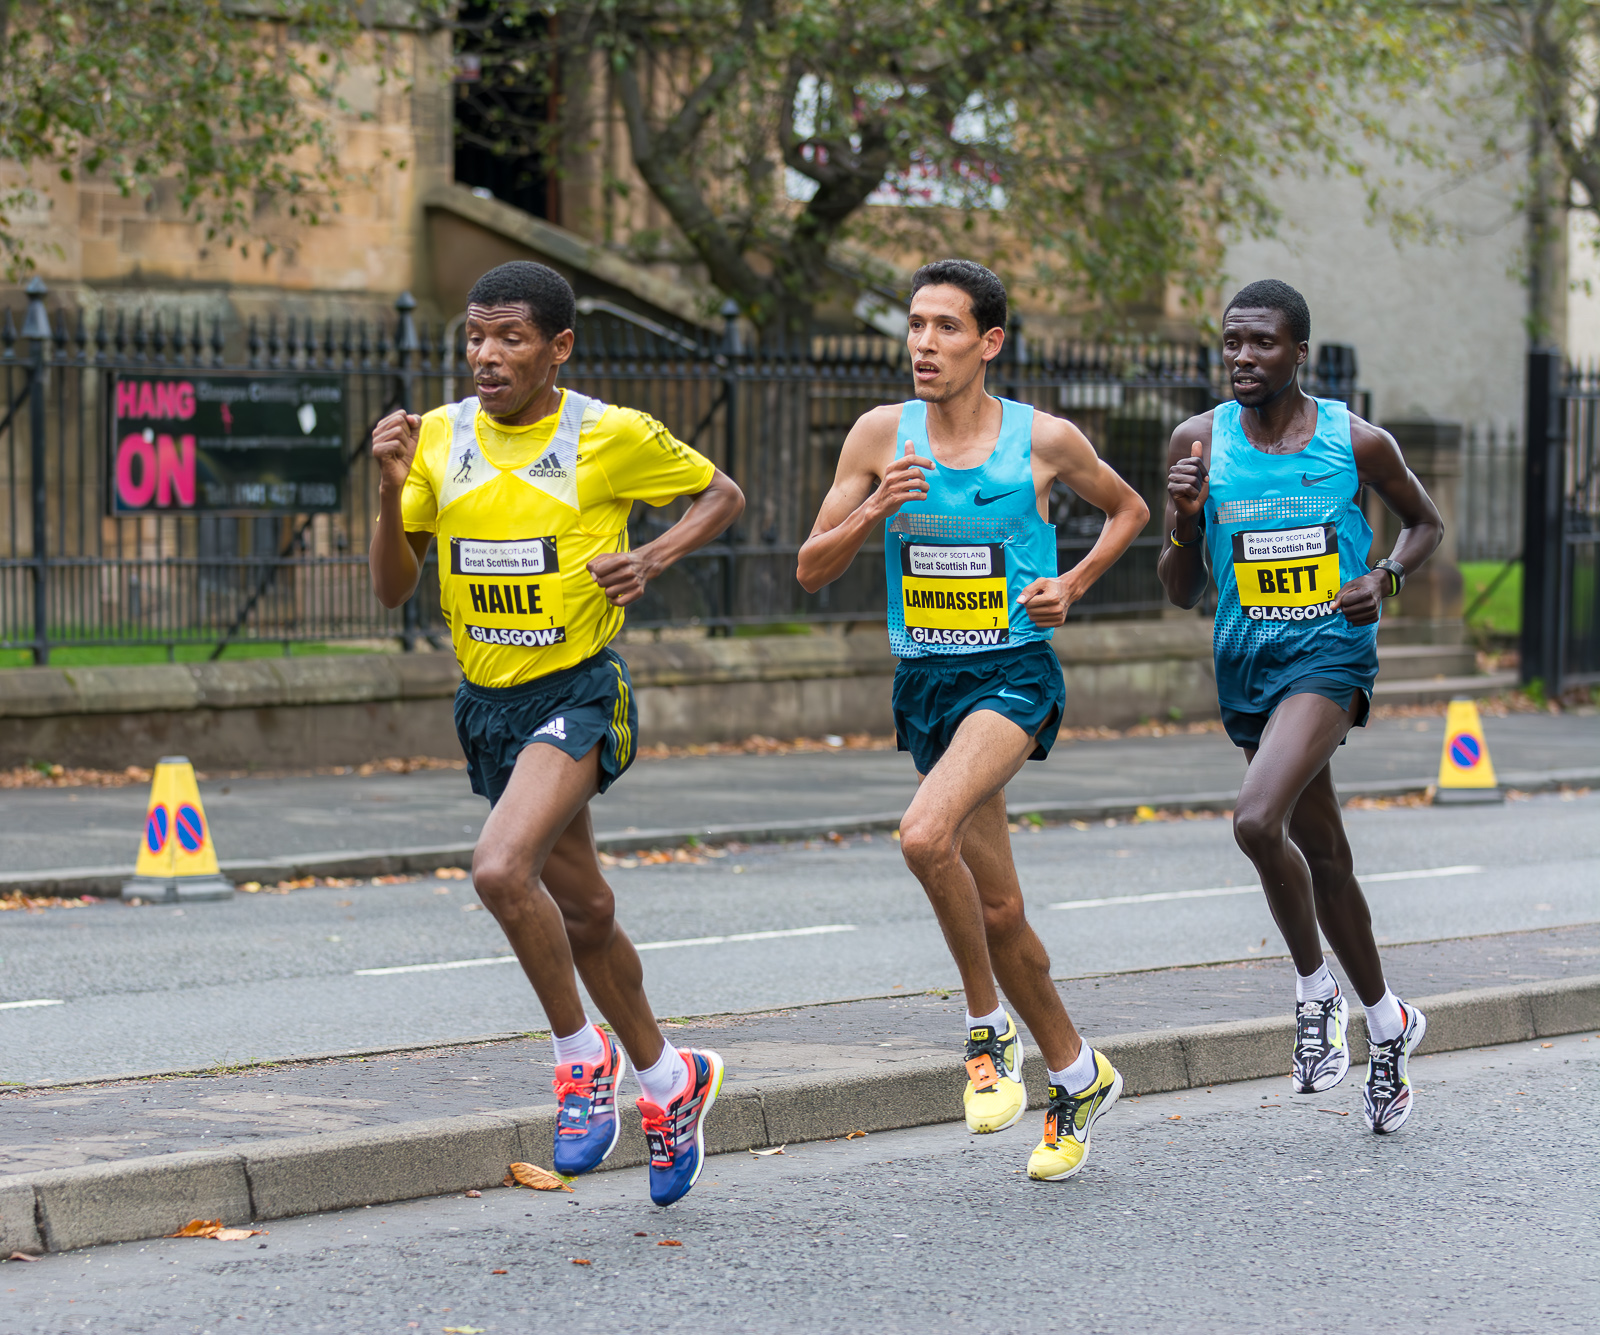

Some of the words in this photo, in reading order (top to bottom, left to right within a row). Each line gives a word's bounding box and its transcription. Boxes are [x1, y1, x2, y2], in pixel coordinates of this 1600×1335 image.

[117, 381, 197, 420] HANG
[117, 432, 197, 508] ON
[529, 468, 567, 478] adidas
[1286, 532, 1321, 542] SCOTLAND
[472, 547, 487, 555] BANK
[500, 547, 538, 556] SCOTLAND
[1249, 546, 1270, 555] Great
[1272, 543, 1305, 554] Scottish
[1306, 542, 1322, 551] Run
[920, 551, 938, 559] BANK
[939, 551, 948, 559] OF
[949, 551, 986, 559] SCOTLAND
[465, 557, 485, 567] Great
[486, 558, 520, 568] Scottish
[521, 558, 539, 567] Run
[914, 560, 934, 570] Great
[935, 561, 968, 571] Scottish
[970, 562, 987, 570] Run
[1257, 564, 1319, 594] BETT
[469, 584, 543, 614] HAILE
[905, 589, 1004, 610] LAMDASSEM
[1327, 589, 1333, 599] 5
[1248, 601, 1334, 621] GLASGOW
[549, 616, 554, 626] 1
[992, 616, 998, 627] 7
[471, 626, 557, 647] GLASGOW
[912, 627, 1000, 645] GLASGOW
[973, 1030, 986, 1038] NIKE
